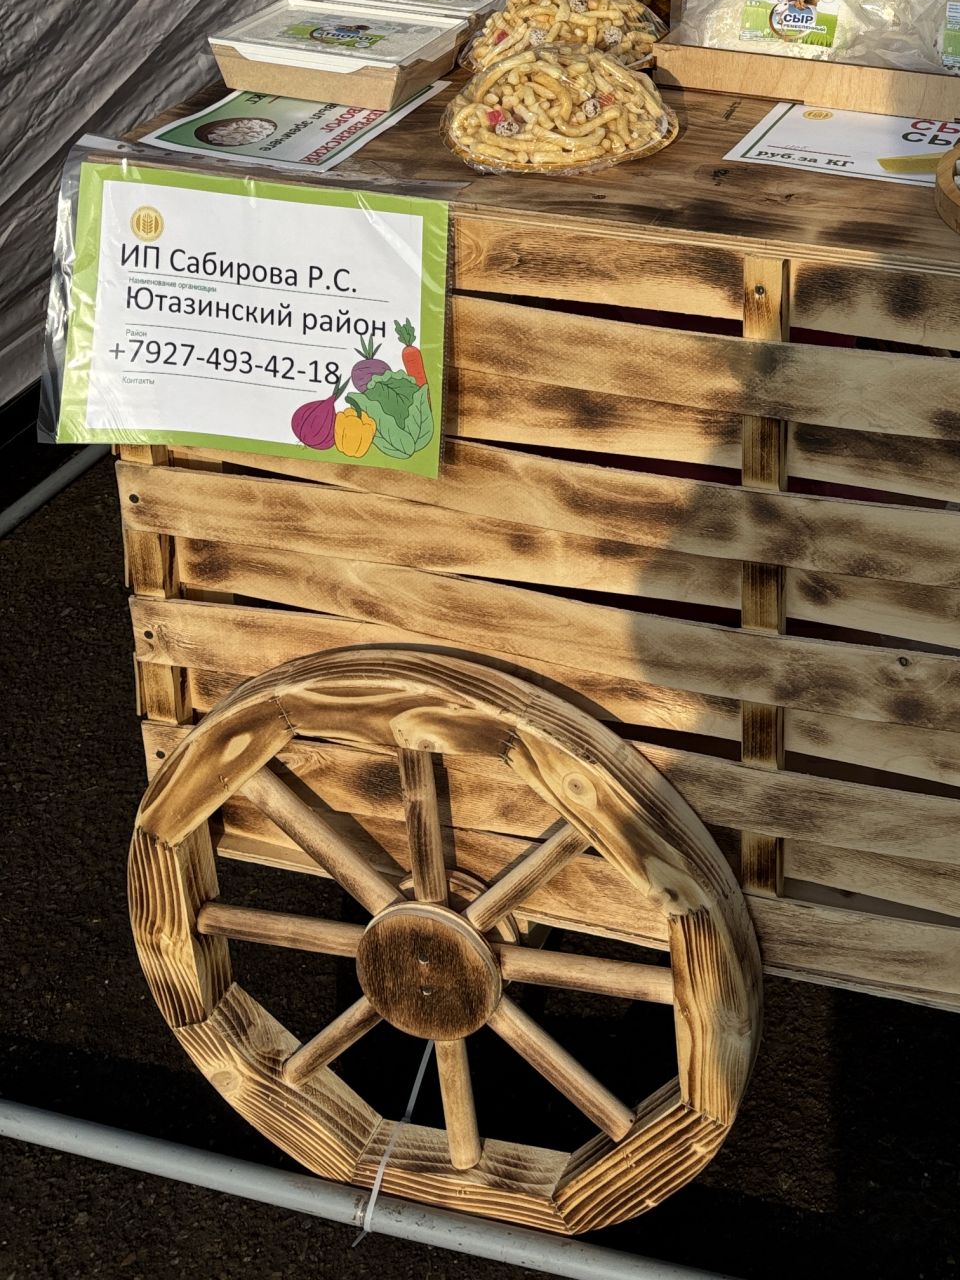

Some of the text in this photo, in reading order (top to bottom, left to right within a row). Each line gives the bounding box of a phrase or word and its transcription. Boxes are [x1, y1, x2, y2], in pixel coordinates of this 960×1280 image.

[783, 13, 814, 24] СЫР
[320, 106, 365, 133] ВОРОГ
[300, 109, 386, 164] ЕРЕВЕНСКИЙ
[120, 243, 357, 293] ИП Сабирова Р.С.
[128, 277, 177, 288] Наименование
[126, 286, 386, 338] Ютазинский район
[125, 328, 147, 337] Район
[109, 339, 340, 384] +7927-493-42-18
[122, 375, 155, 385] Контакты
